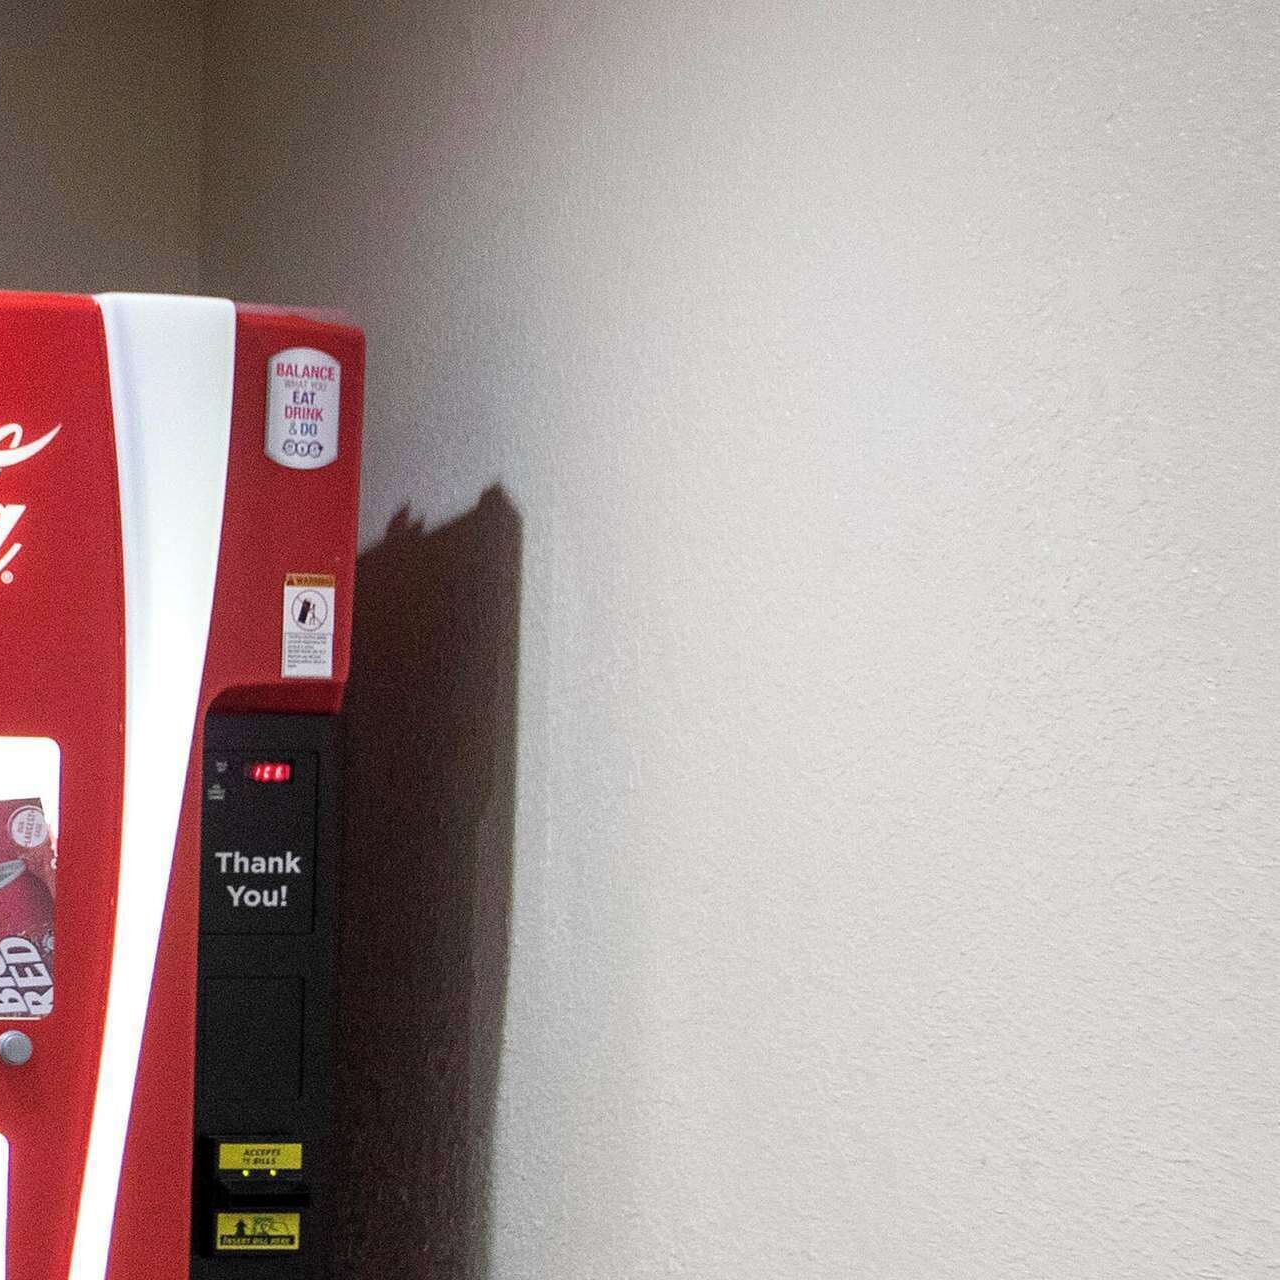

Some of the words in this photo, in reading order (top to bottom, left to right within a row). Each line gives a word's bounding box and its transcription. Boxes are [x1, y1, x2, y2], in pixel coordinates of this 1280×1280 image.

[276, 363, 335, 382] BALANCE
[292, 391, 316, 405] EAT
[284, 405, 323, 421] DRINK
[288, 423, 298, 435] &
[300, 423, 318, 437] DO
[214, 851, 301, 874] Thank
[226, 882, 287, 907] You!
[0, 936, 54, 1015] RED
